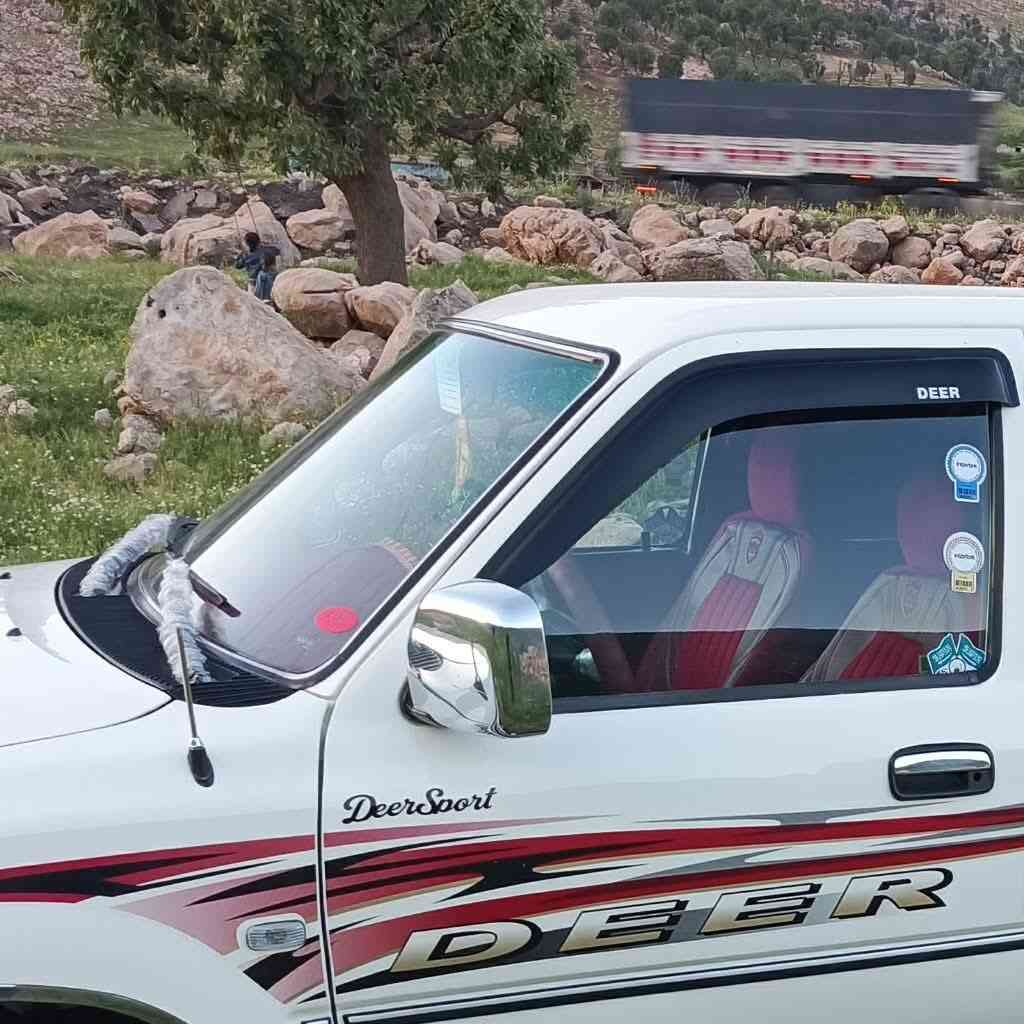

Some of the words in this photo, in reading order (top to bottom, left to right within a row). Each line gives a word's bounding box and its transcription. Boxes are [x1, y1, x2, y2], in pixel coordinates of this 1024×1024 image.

[916, 386, 961, 400] DEER
[341, 787, 498, 825] DeerSport
[390, 867, 954, 975] DEER
